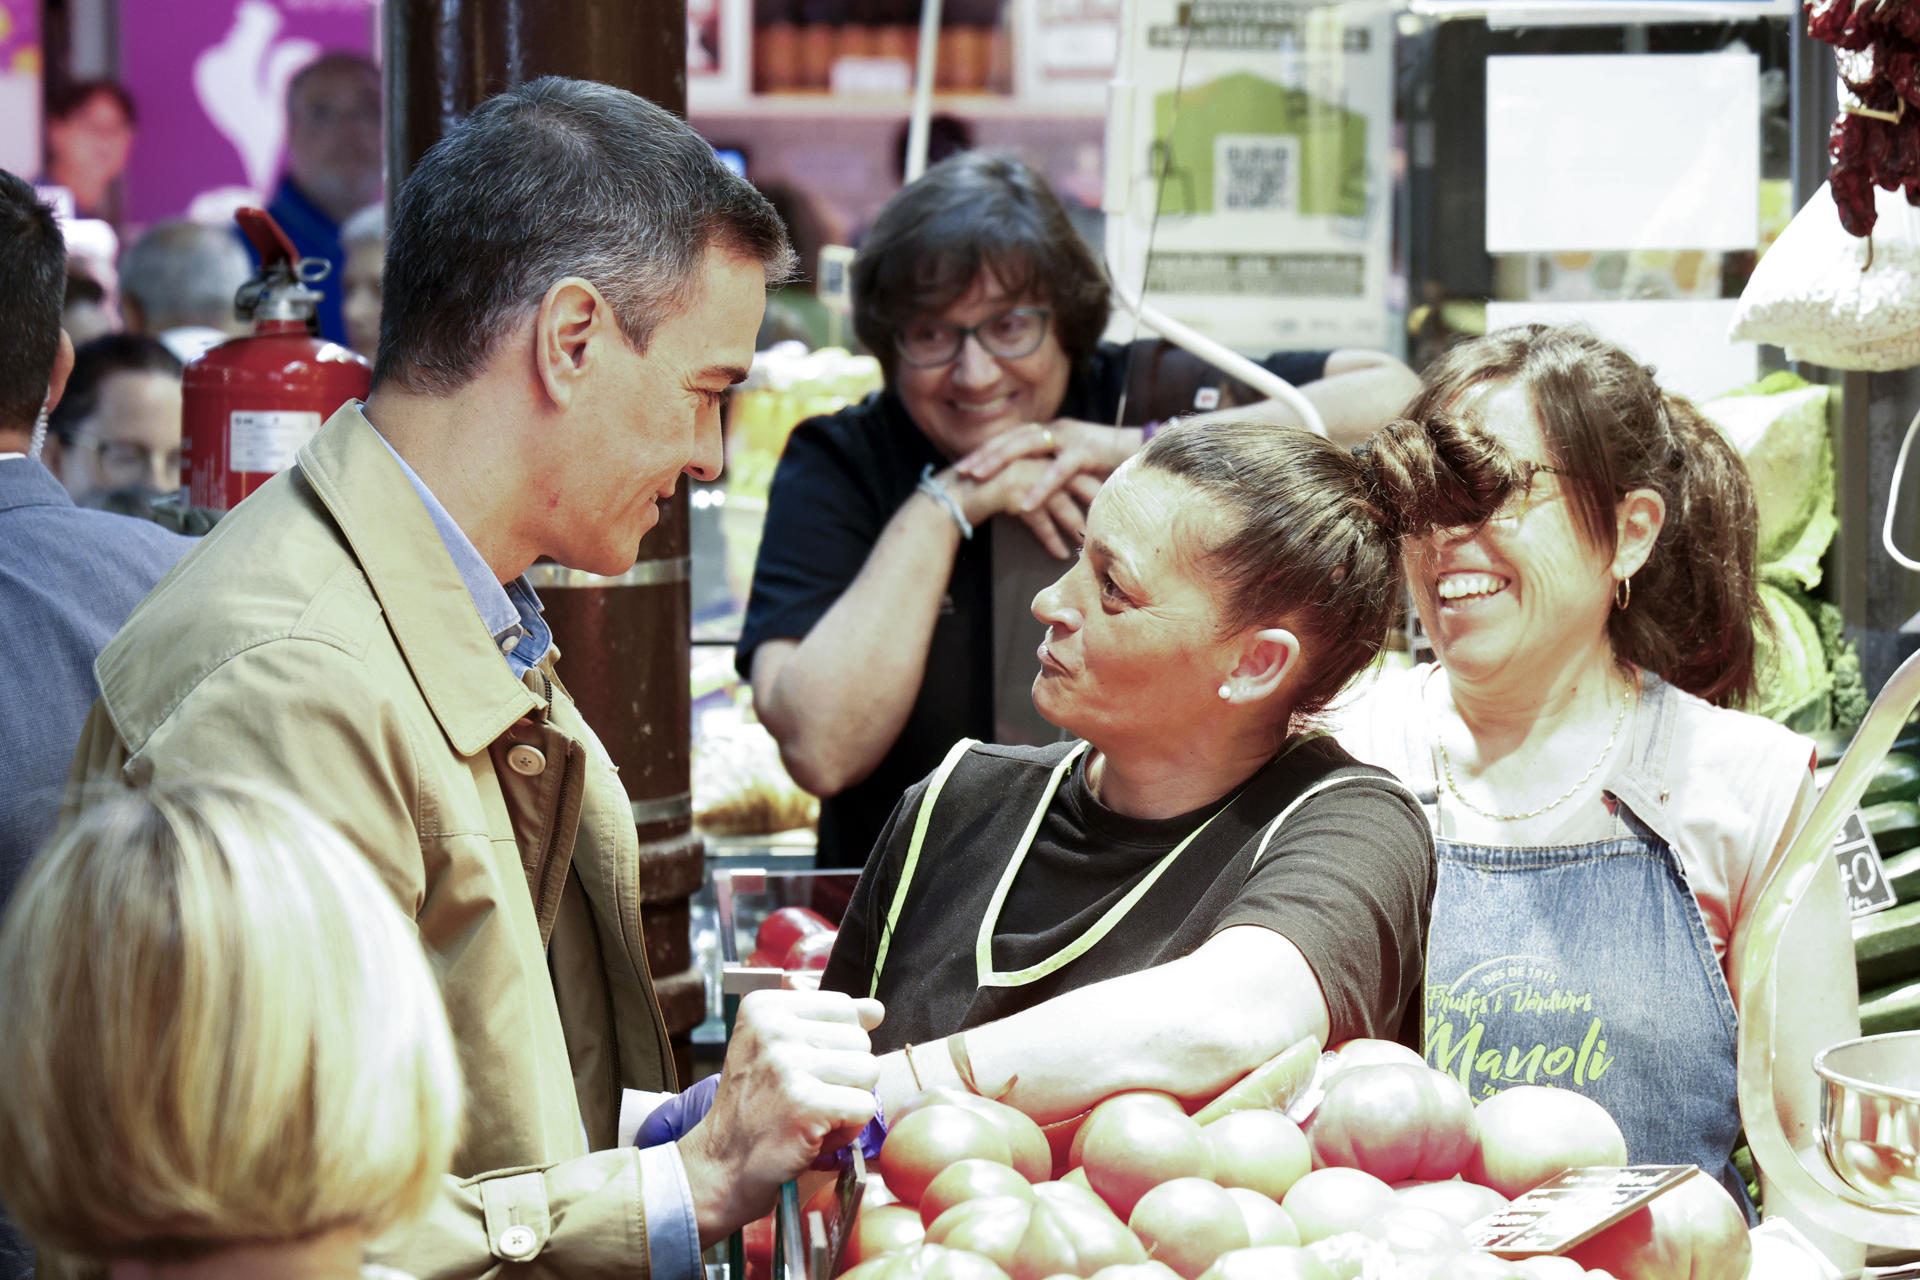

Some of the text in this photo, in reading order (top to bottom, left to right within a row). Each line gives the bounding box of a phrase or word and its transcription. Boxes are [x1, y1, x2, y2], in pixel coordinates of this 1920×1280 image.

[1481, 968, 1506, 986] DES
[1507, 965, 1526, 978] DE
[1428, 984, 1592, 1018] Fruites i Verdures
[1428, 1016, 1615, 1094] Manoli
